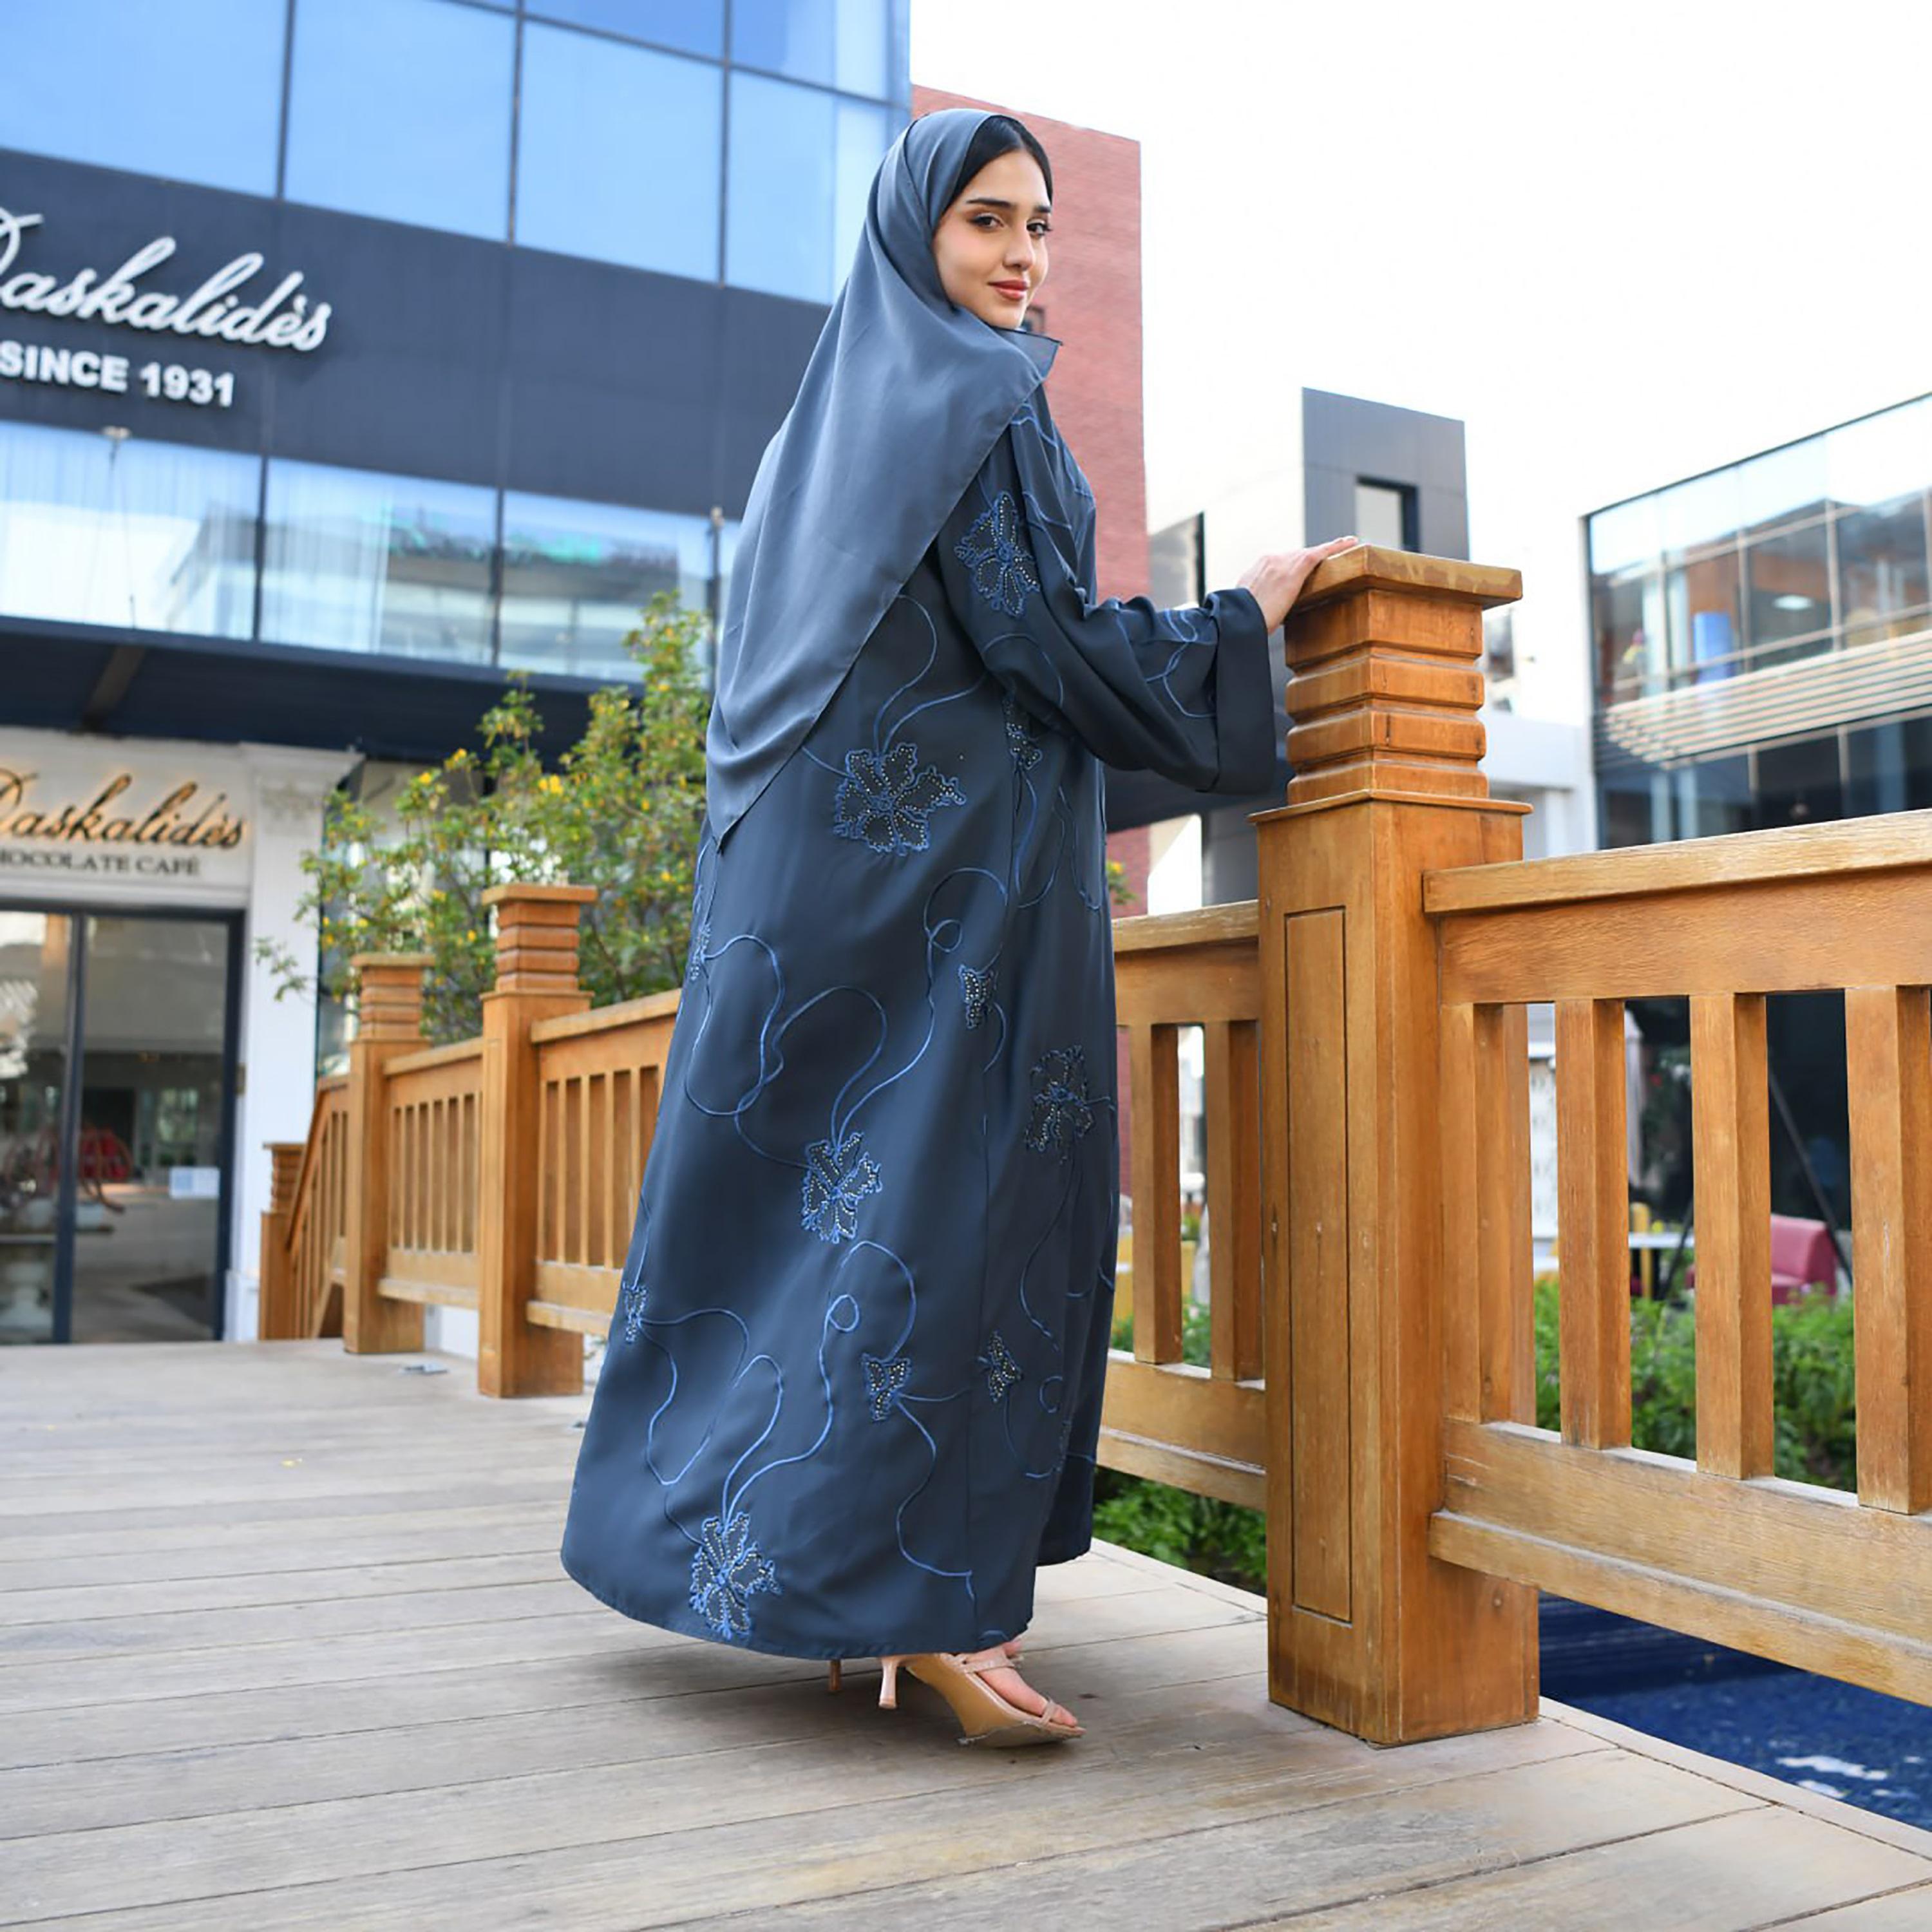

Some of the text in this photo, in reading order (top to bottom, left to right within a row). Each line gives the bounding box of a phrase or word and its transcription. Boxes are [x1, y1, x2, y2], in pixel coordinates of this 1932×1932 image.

[0, 340, 235, 408] SINCE 1931
[0, 849, 129, 873] HOCOLATE
